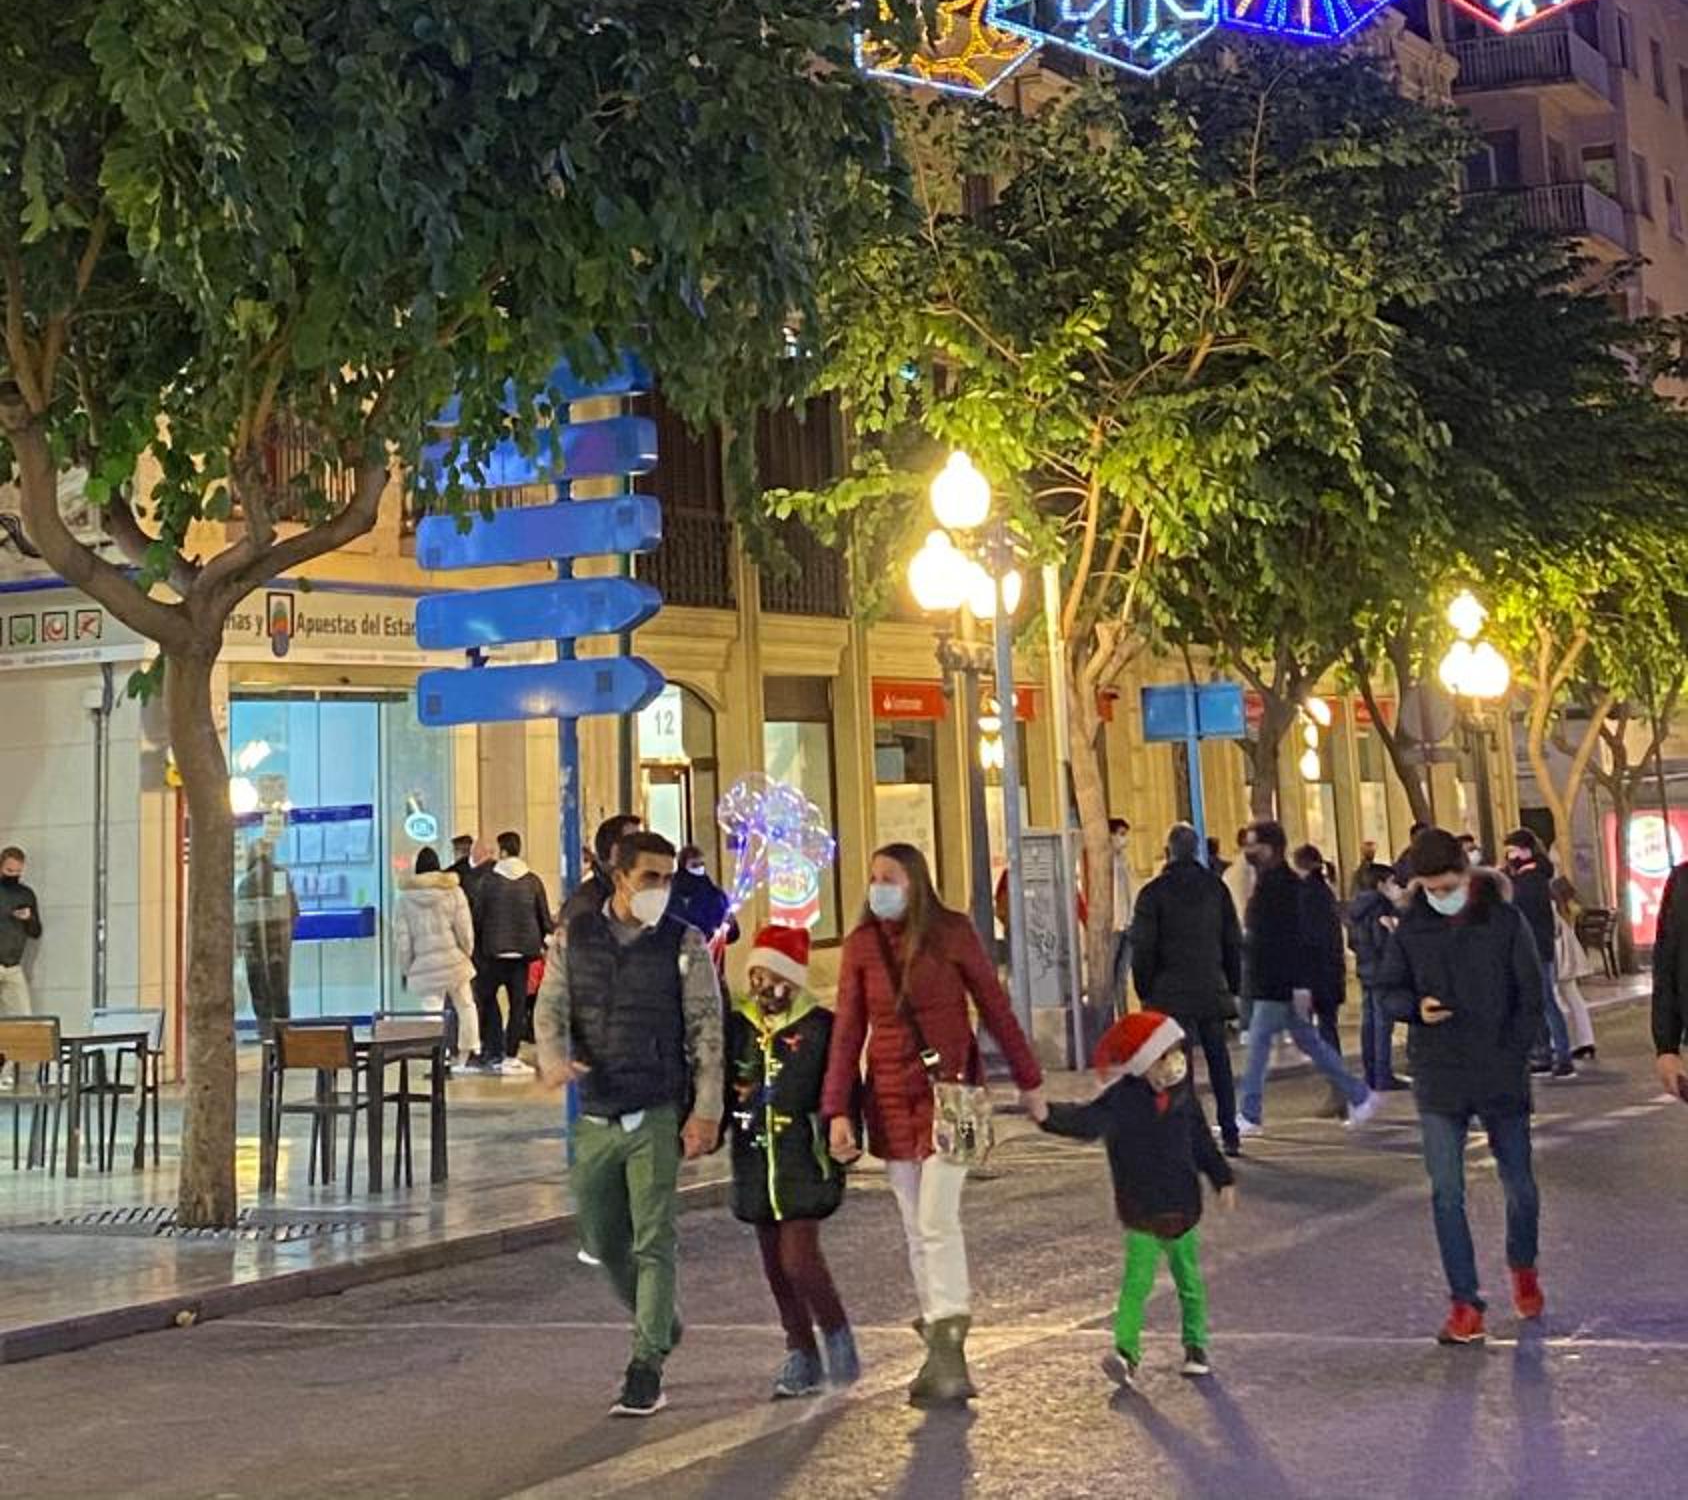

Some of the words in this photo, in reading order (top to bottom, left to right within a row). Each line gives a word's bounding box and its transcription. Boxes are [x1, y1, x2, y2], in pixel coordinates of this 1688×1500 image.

[256, 614, 263, 636] y
[296, 612, 356, 637] Apuestas
[361, 612, 380, 635] del
[655, 709, 675, 736] 12
